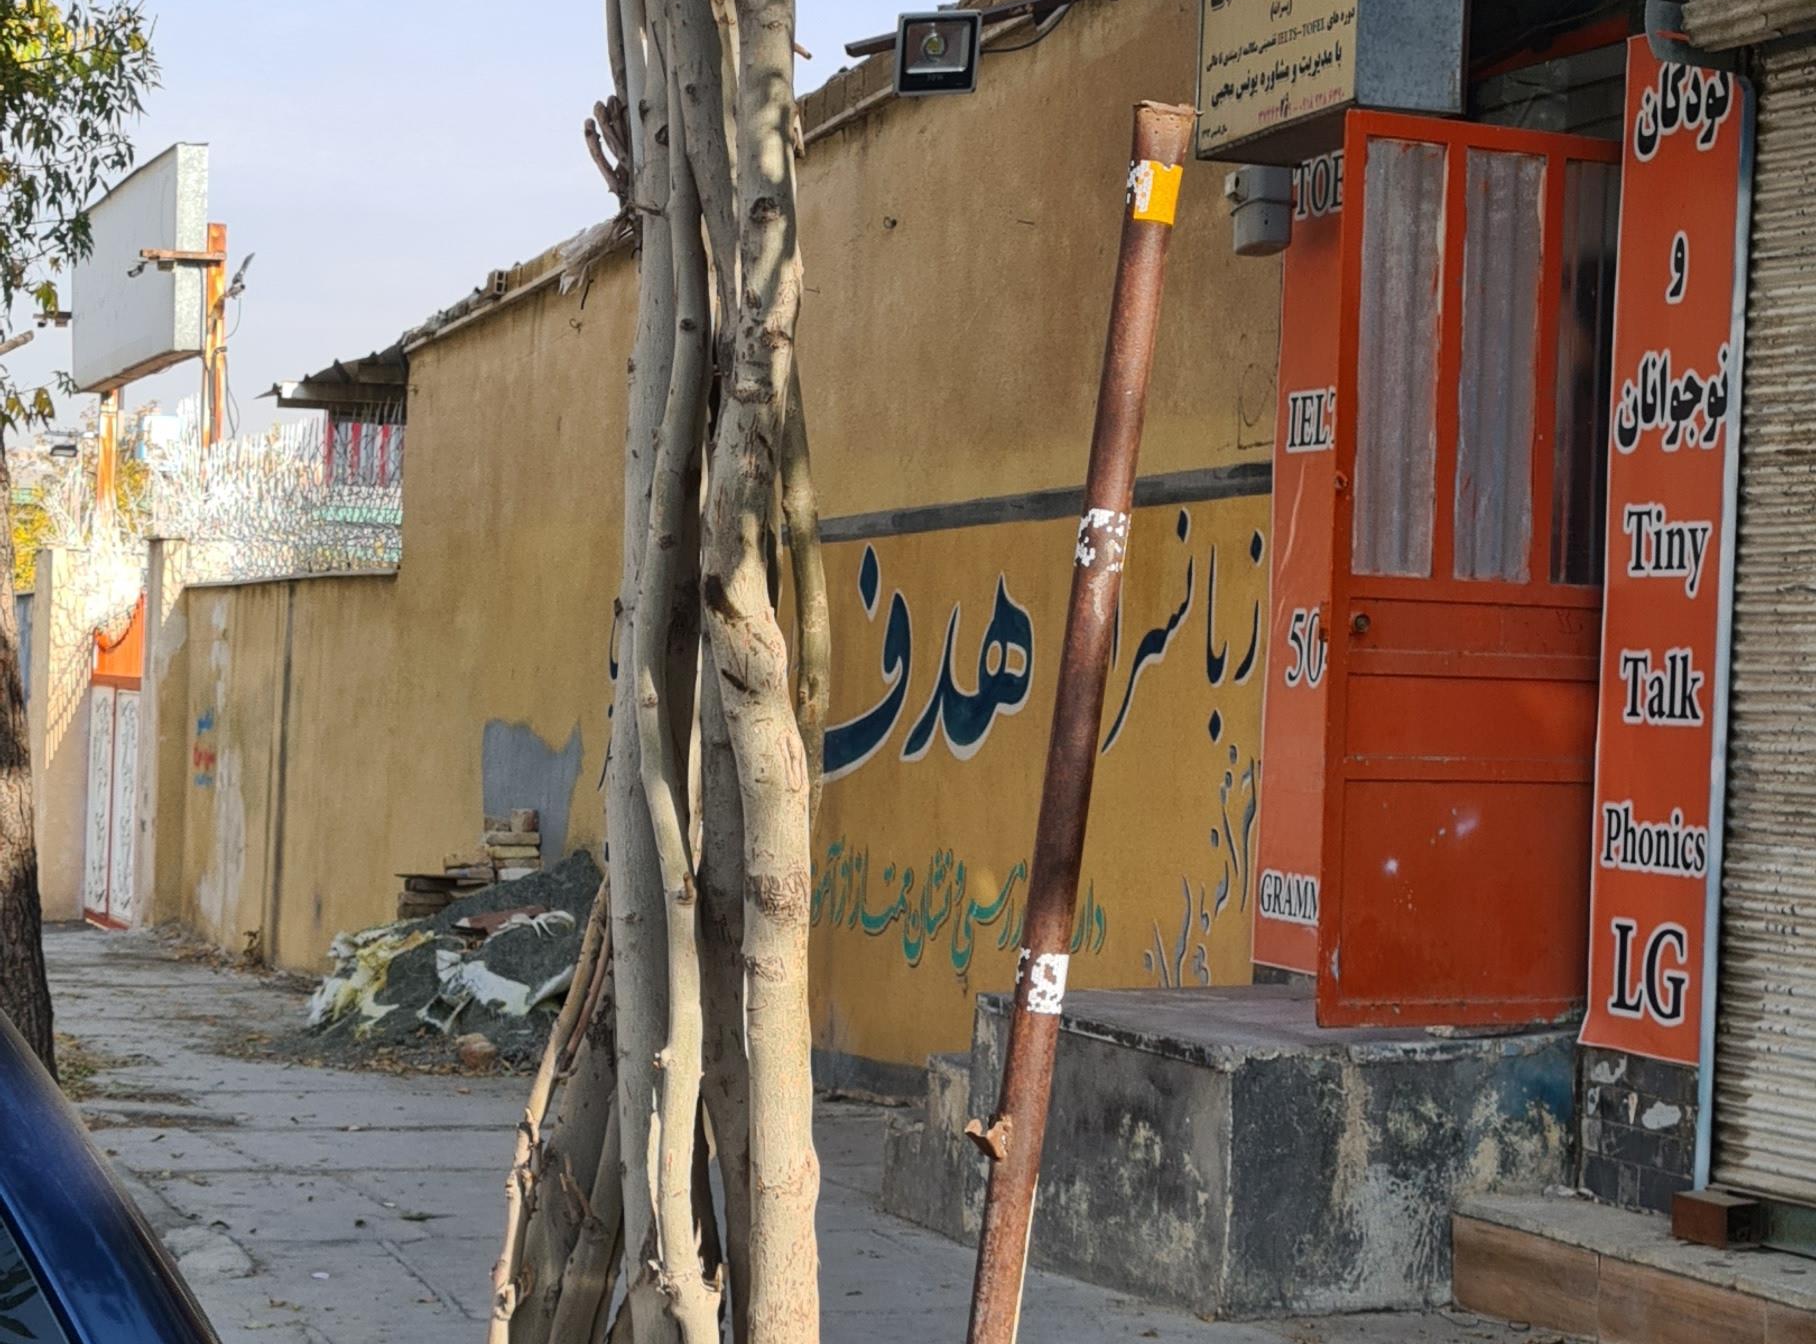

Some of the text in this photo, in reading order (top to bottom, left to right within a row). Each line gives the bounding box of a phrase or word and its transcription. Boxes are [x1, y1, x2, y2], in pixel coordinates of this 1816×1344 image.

[1667, 232, 1687, 301] و
[1287, 391, 1336, 450] IEL
[1615, 344, 1730, 452] نوجوانان
[1625, 506, 1710, 595] Tiny
[823, 544, 1033, 778] هدف
[1102, 507, 1264, 753] زبانسرا
[1286, 610, 1326, 686] 50
[1622, 651, 1702, 720] Talk
[1604, 806, 1707, 874] Phonics
[1611, 921, 1687, 1024] LG
